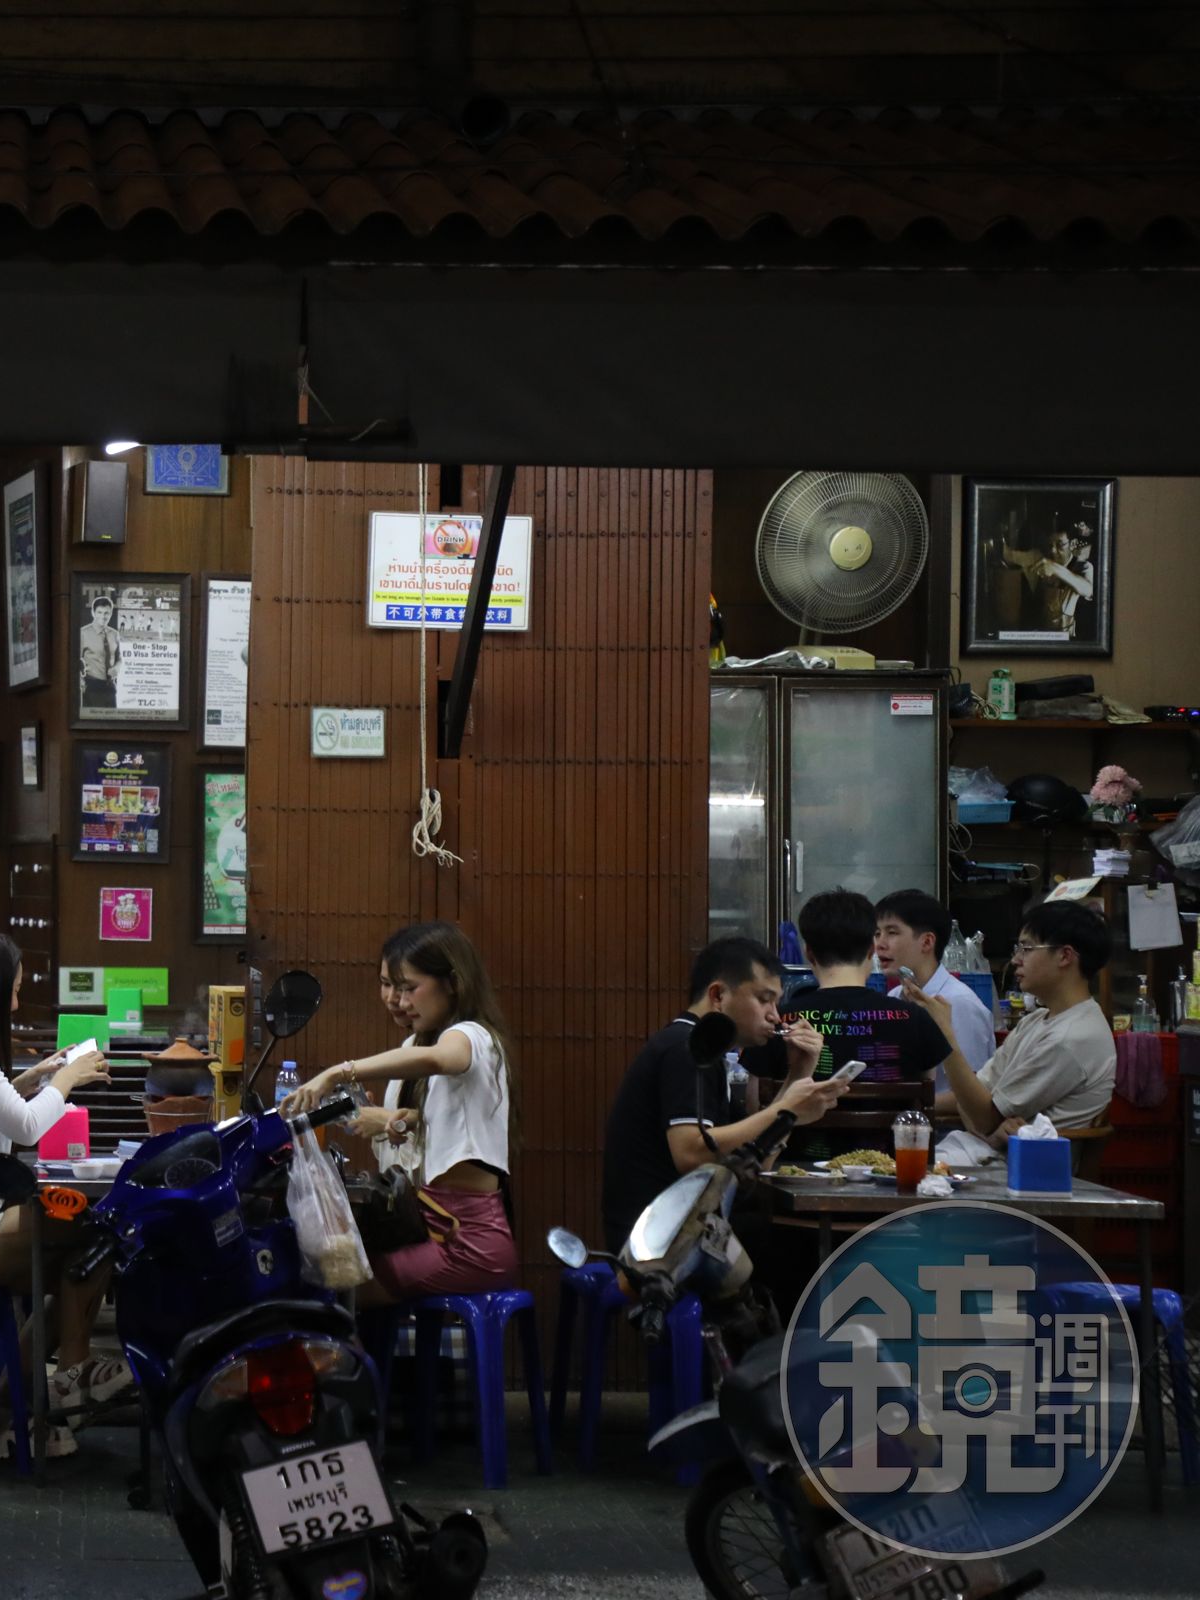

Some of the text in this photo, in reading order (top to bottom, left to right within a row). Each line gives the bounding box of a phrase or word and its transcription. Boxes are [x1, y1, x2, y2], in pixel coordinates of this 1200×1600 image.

[151, 643, 168, 651] Stop
[822, 1009, 834, 1022] of
[834, 1010, 849, 1021] the
[851, 1009, 910, 1021] SPHERES
[846, 1024, 873, 1036] 2024
[281, 1439, 317, 1455] HONDA
[276, 1451, 345, 1489] 1กธ
[287, 1481, 349, 1514] เพชรบุรี
[279, 1504, 375, 1549] 5823
